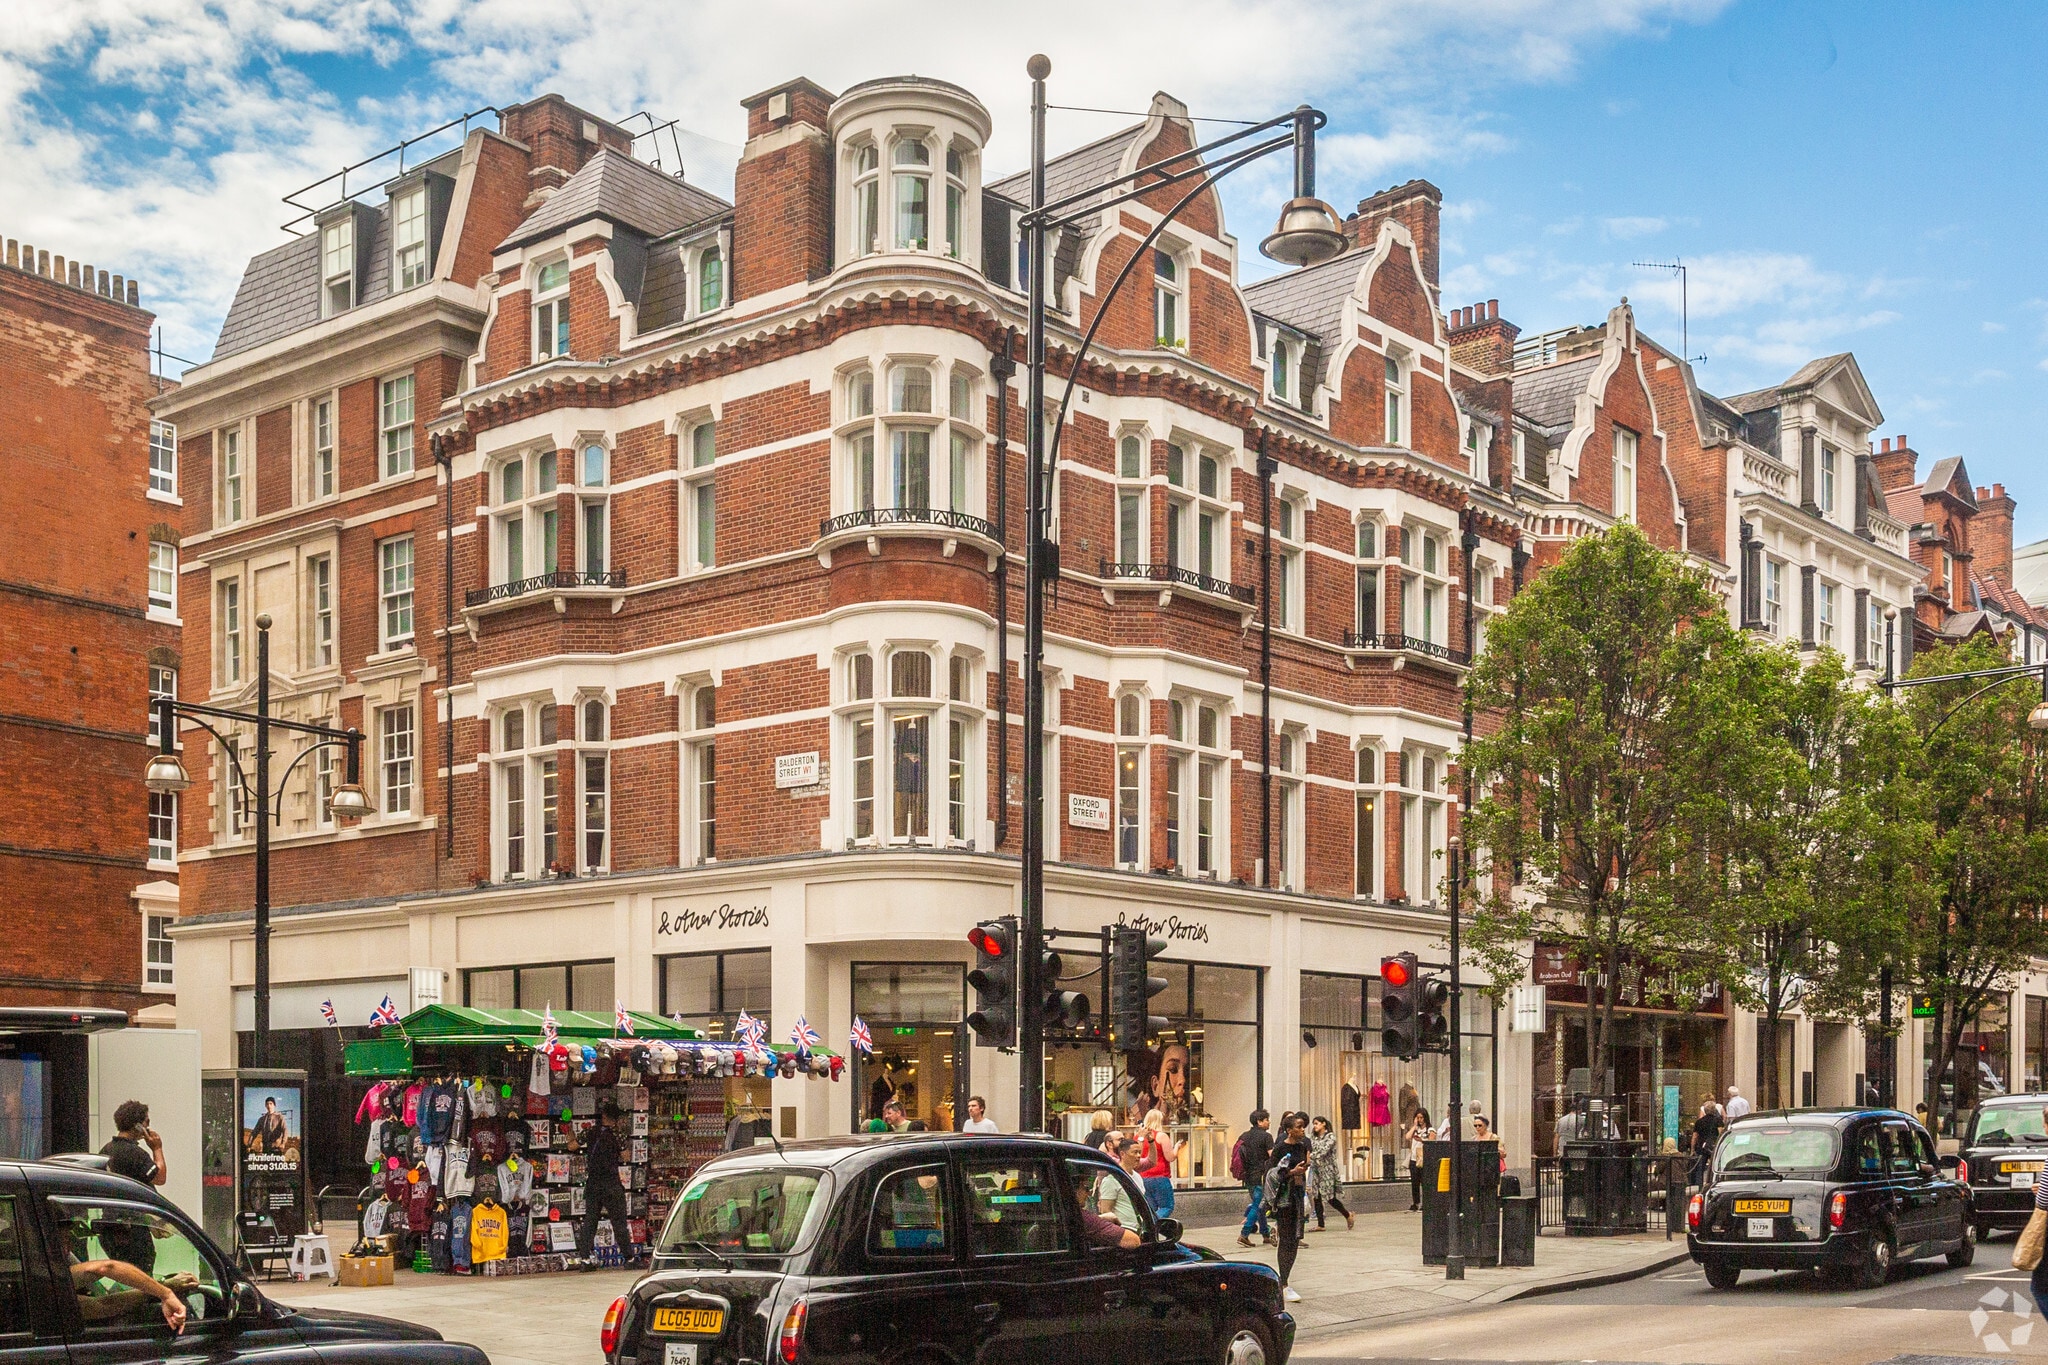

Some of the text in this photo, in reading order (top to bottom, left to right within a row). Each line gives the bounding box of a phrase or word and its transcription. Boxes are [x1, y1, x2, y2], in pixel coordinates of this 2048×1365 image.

[779, 755, 815, 768] BALDERTON
[779, 765, 812, 778] STREET W1
[1073, 797, 1100, 809] OXFORD
[1073, 807, 1097, 818] STREET
[658, 903, 770, 935] & other Stories
[1168, 915, 1209, 943] Stories
[1539, 970, 1572, 979] Arabian Oud
[247, 1162, 297, 1171] since 31.08.15
[1740, 1200, 1785, 1210] LA56 VUH
[477, 1218, 501, 1230] LONDON
[659, 1309, 692, 1327] LC05
